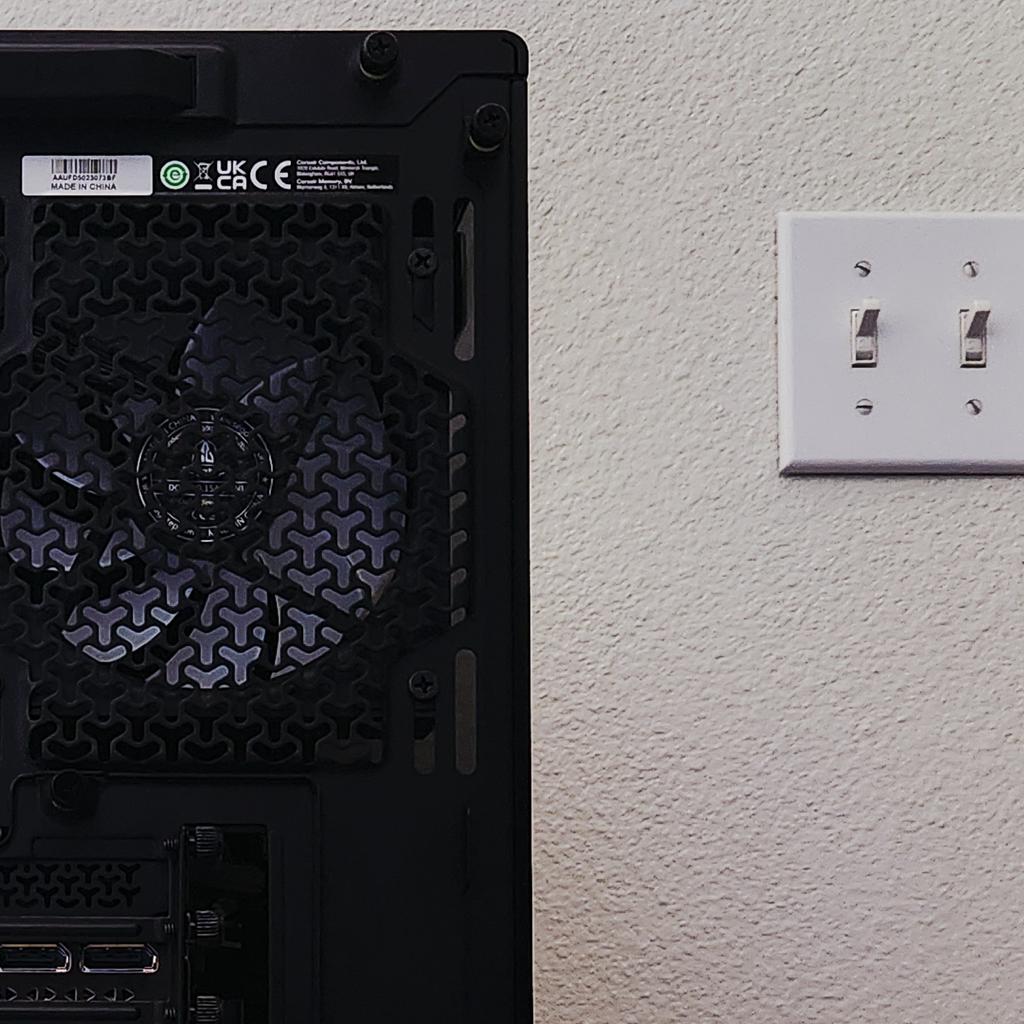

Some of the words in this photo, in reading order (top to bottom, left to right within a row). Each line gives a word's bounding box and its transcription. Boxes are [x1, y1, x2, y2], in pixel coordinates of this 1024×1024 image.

[216, 160, 247, 175] UK
[250, 160, 292, 190] CE
[216, 175, 247, 190] CA
